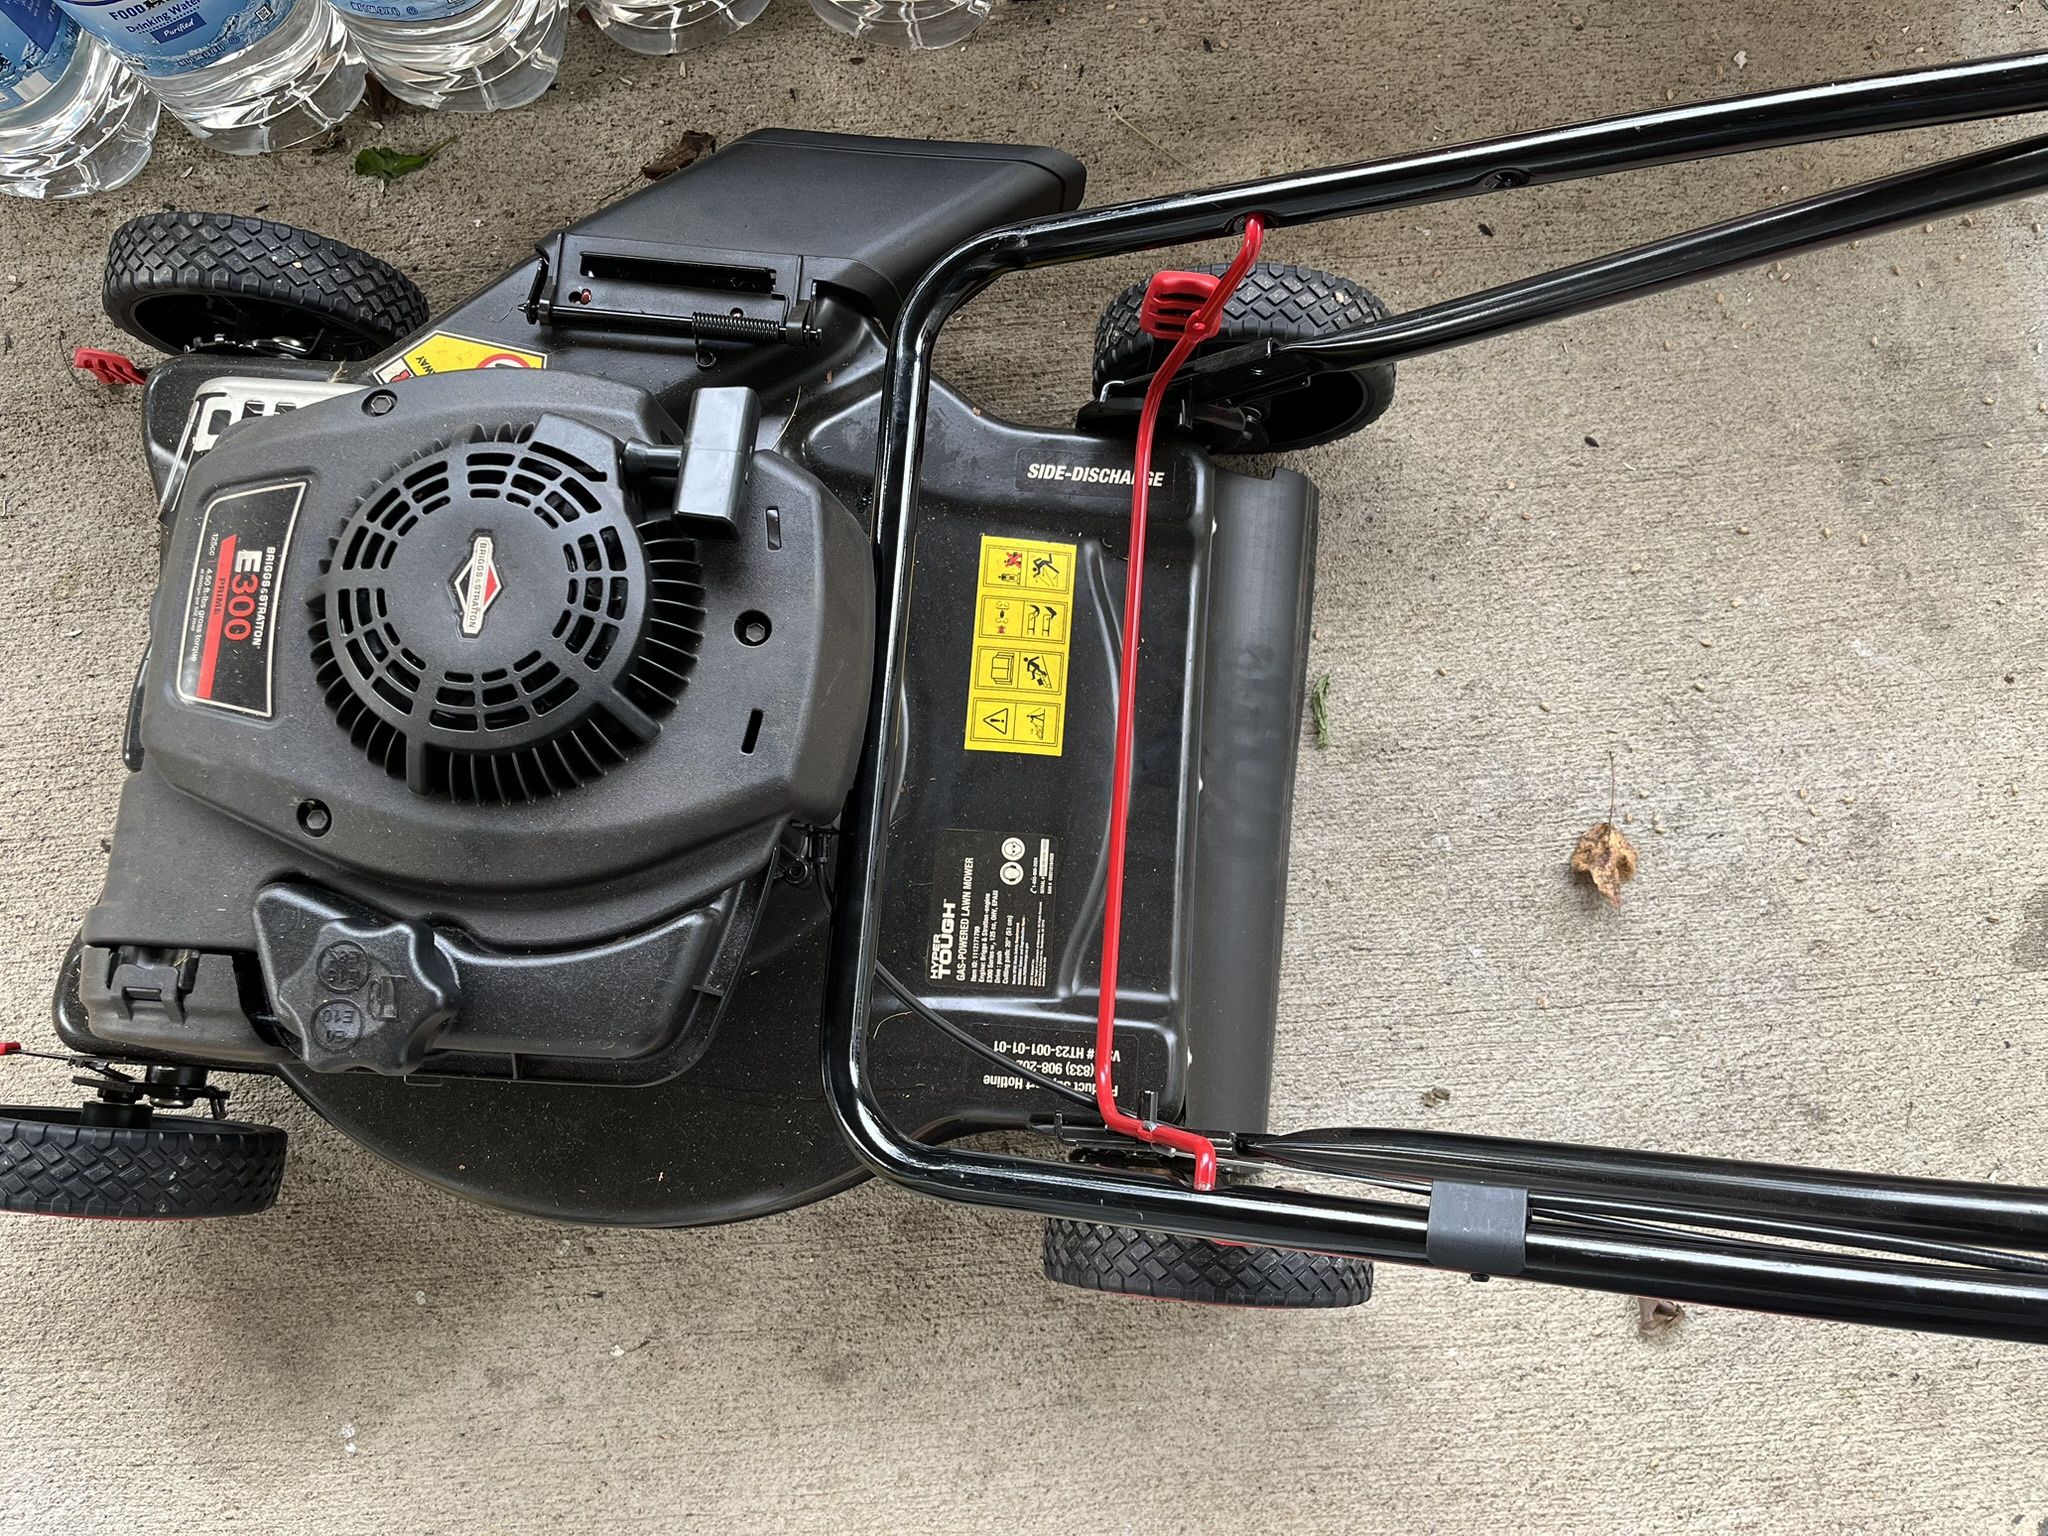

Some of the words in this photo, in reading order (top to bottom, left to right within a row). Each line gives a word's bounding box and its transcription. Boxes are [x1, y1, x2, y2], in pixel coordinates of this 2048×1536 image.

[108, 4, 146, 21] FOOD
[125, 12, 171, 33] Drinking
[163, 18, 194, 37] Purified
[209, 533, 218, 556] 125cc
[204, 568, 213, 586] 4.50
[214, 577, 226, 616] PRIME
[224, 549, 263, 640] E300
[196, 610, 205, 633] gross
[191, 634, 202, 662] torque
[964, 857, 974, 890] MOWER
[961, 891, 971, 917] LAWN
[1006, 915, 1014, 927] cm)
[930, 933, 941, 979] HYPER
[956, 918, 969, 981] GAS-POWERED
[980, 943, 988, 961] Briggs
[987, 951, 995, 968] Series
[970, 969, 978, 982] Item
[978, 962, 987, 983] Engine:
[994, 969, 1002, 984] Drive
[1002, 963, 1011, 985] Cutting
[993, 1040, 1085, 1060] HT23-001-01-01
[1065, 1062, 1095, 1078] (833)
[983, 1075, 1024, 1090] Hotline
